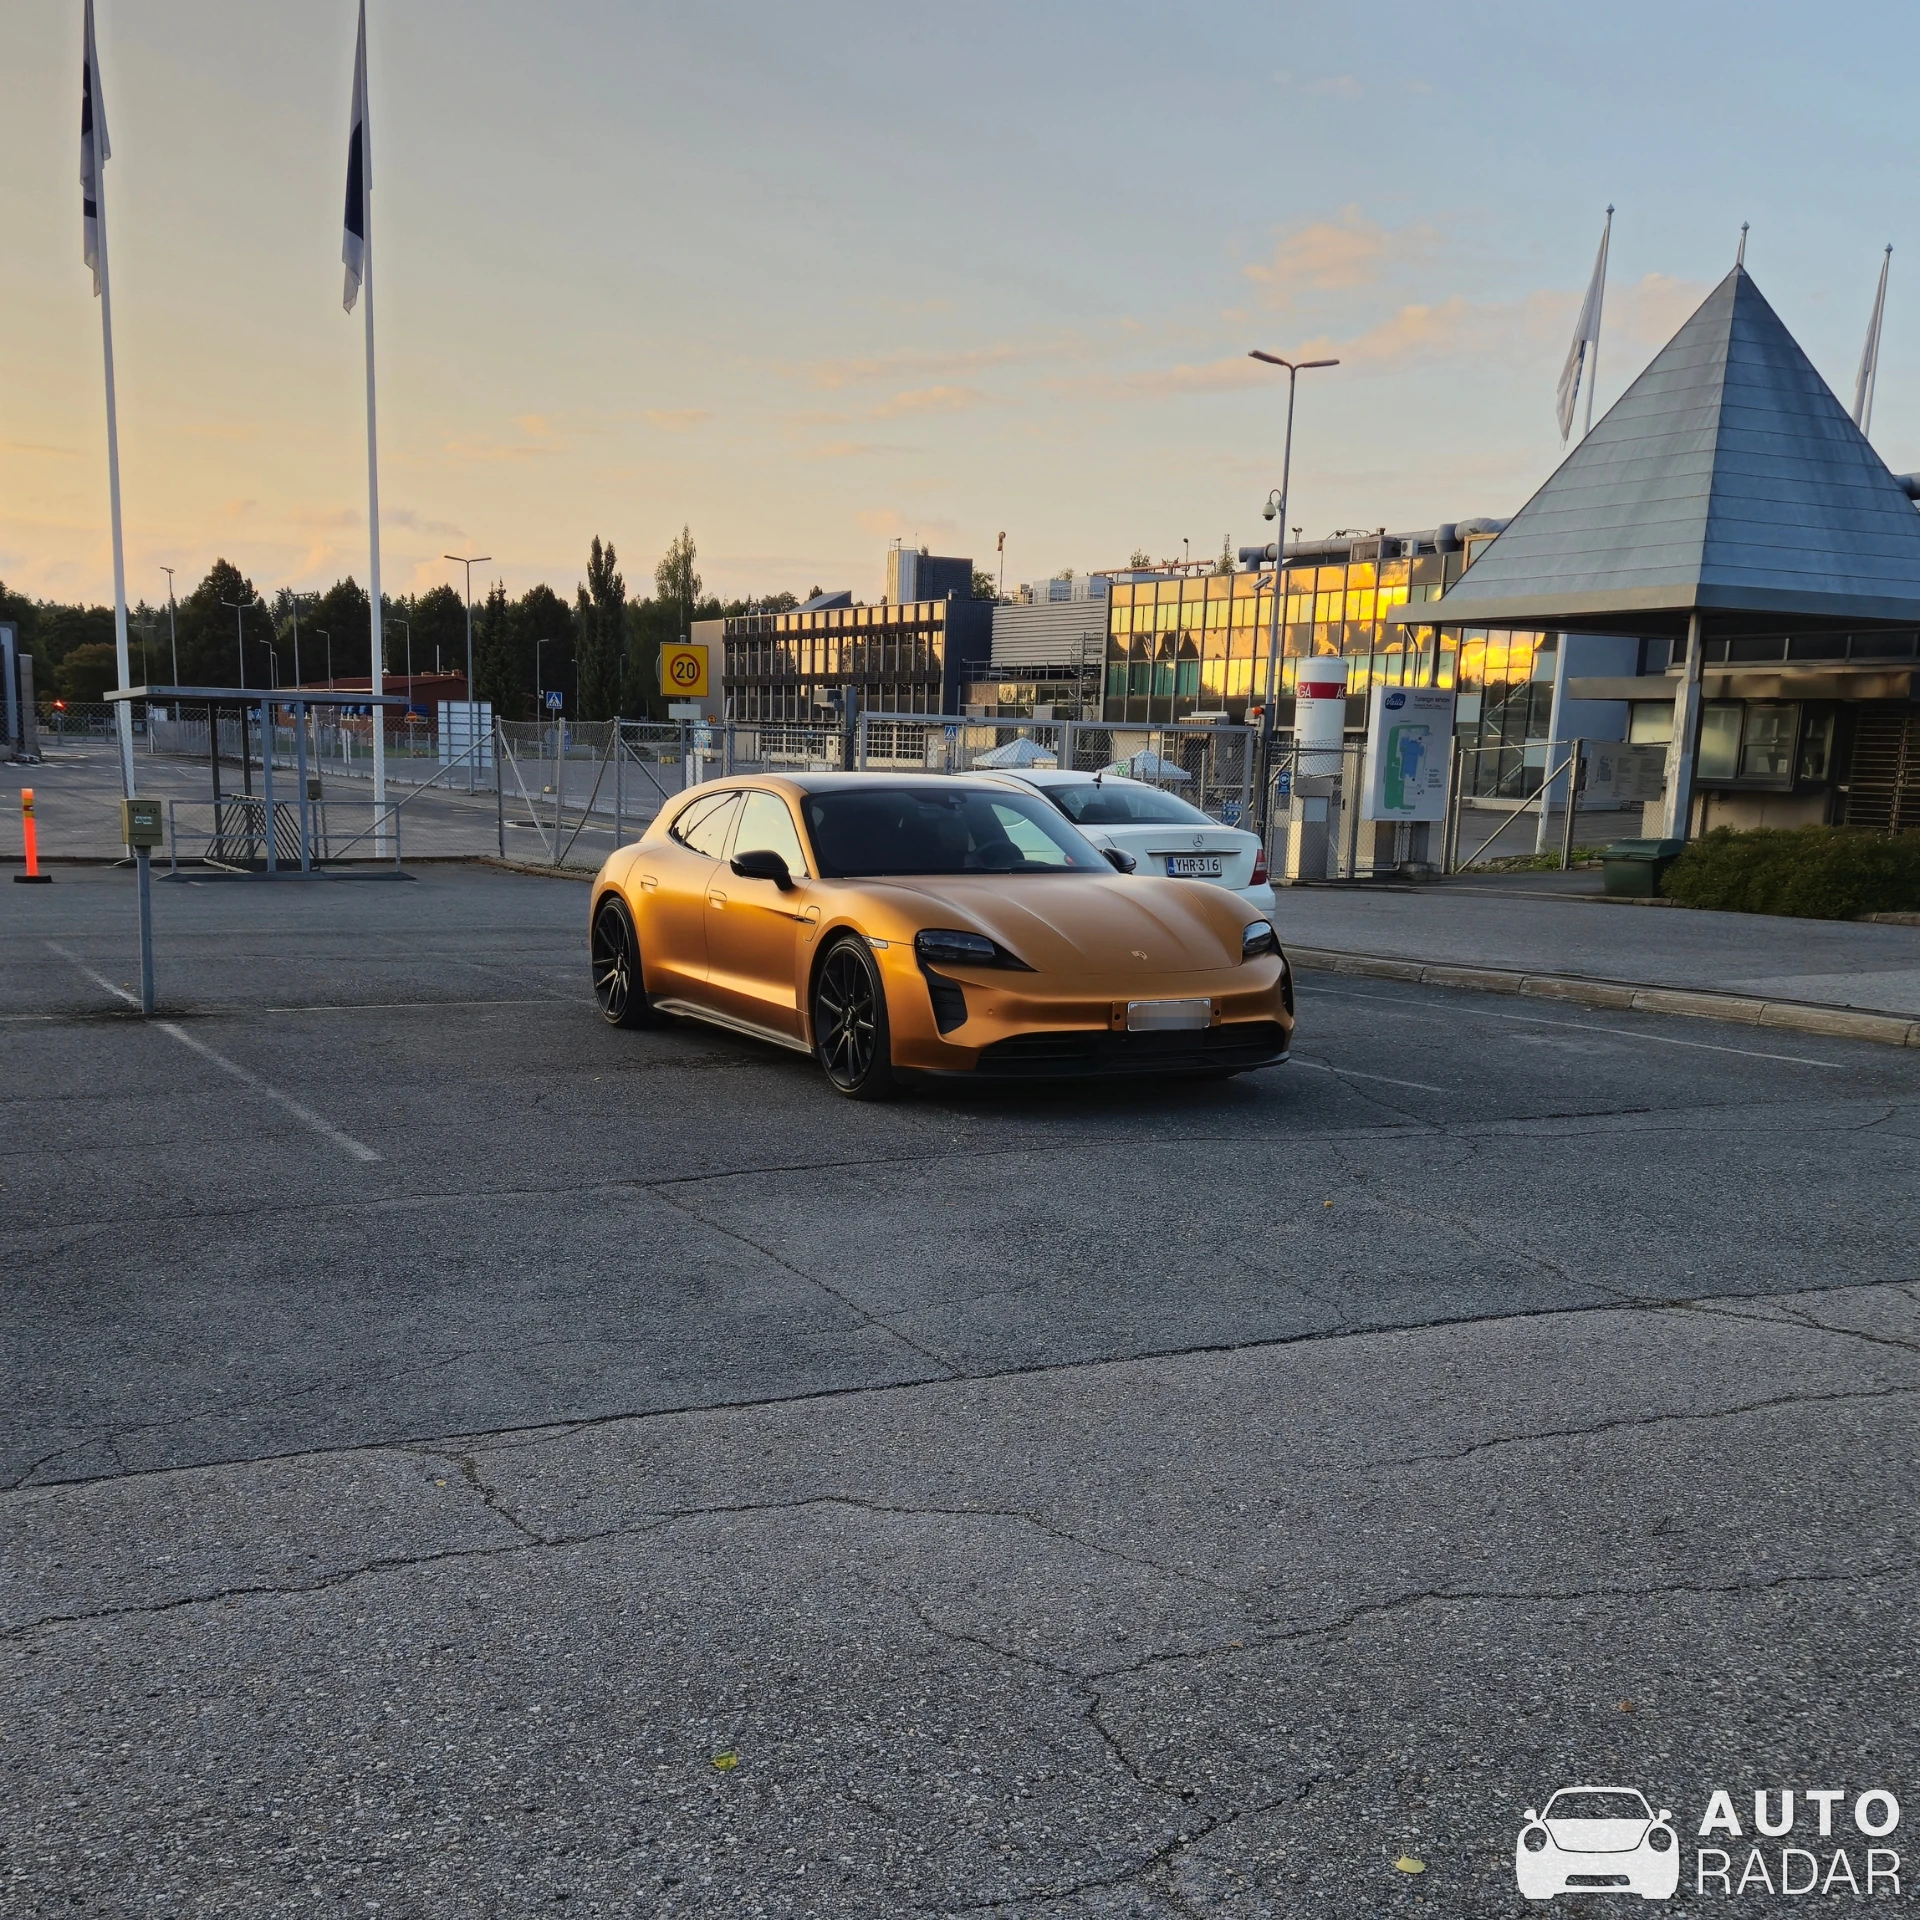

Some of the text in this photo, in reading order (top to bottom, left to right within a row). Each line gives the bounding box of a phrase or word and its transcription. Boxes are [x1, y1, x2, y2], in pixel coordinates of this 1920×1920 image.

[676, 662, 696, 679] 20
[1386, 698, 1404, 706] Valio
[1176, 859, 1219, 871] YHR-316
